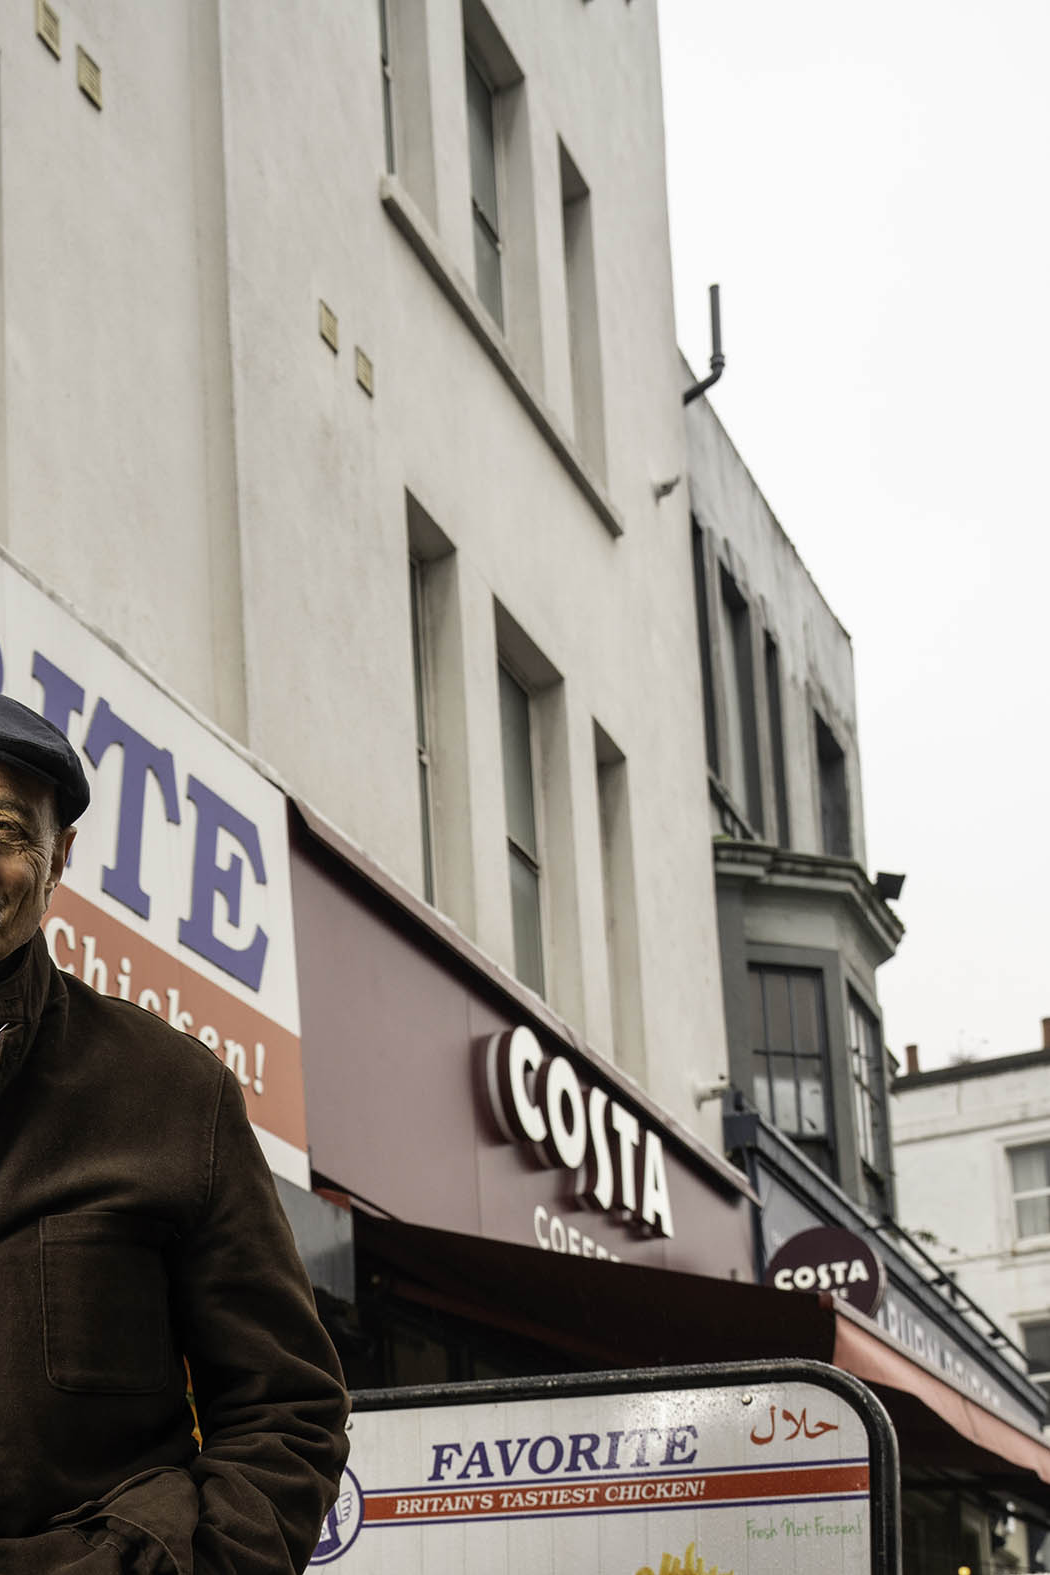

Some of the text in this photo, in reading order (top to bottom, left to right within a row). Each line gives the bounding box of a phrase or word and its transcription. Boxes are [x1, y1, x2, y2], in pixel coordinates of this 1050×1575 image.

[506, 1025, 674, 1239] COSTA
[534, 1204, 621, 1263] COFF
[774, 1259, 869, 1291] COSTA
[750, 1405, 839, 1446] حلال
[427, 1424, 698, 1482] FAVORITE
[395, 1480, 706, 1515] BRITAIN'S TASTIEST CHICKEN!
